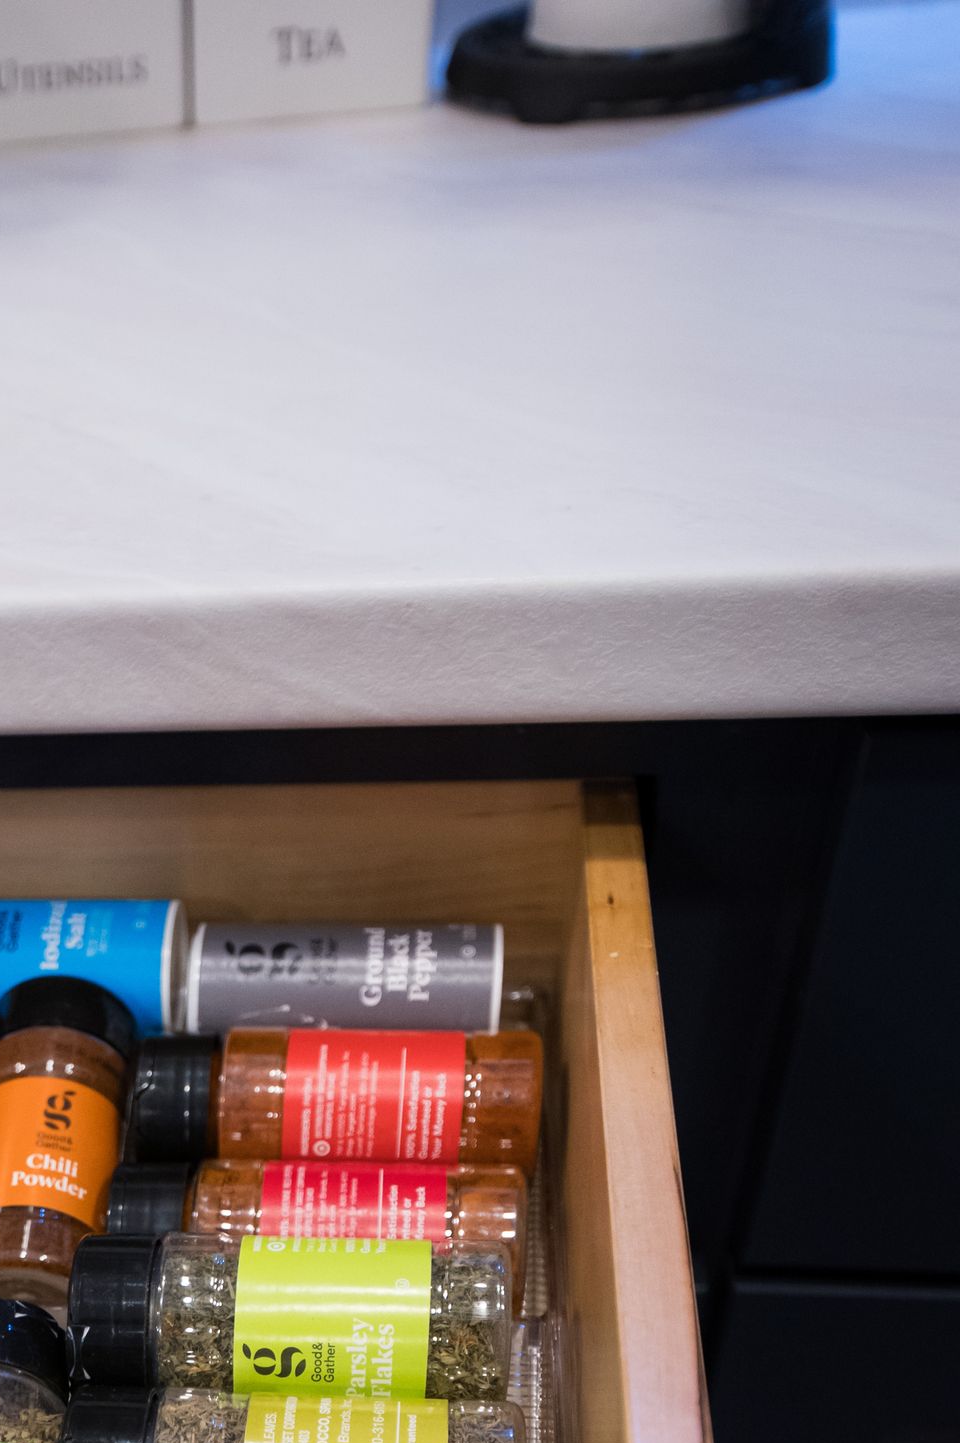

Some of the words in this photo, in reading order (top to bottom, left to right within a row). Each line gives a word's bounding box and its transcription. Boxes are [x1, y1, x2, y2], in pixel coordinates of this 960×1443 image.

[358, 927, 386, 1007] Ground
[386, 933, 410, 991] Black
[406, 929, 437, 1002] Pepper
[10, 1170, 88, 1200] Powder
[25, 1153, 79, 1178] Chili
[323, 1342, 336, 1384] Gather
[345, 1318, 374, 1398] Parsley
[371, 1323, 395, 1398] Flakes
